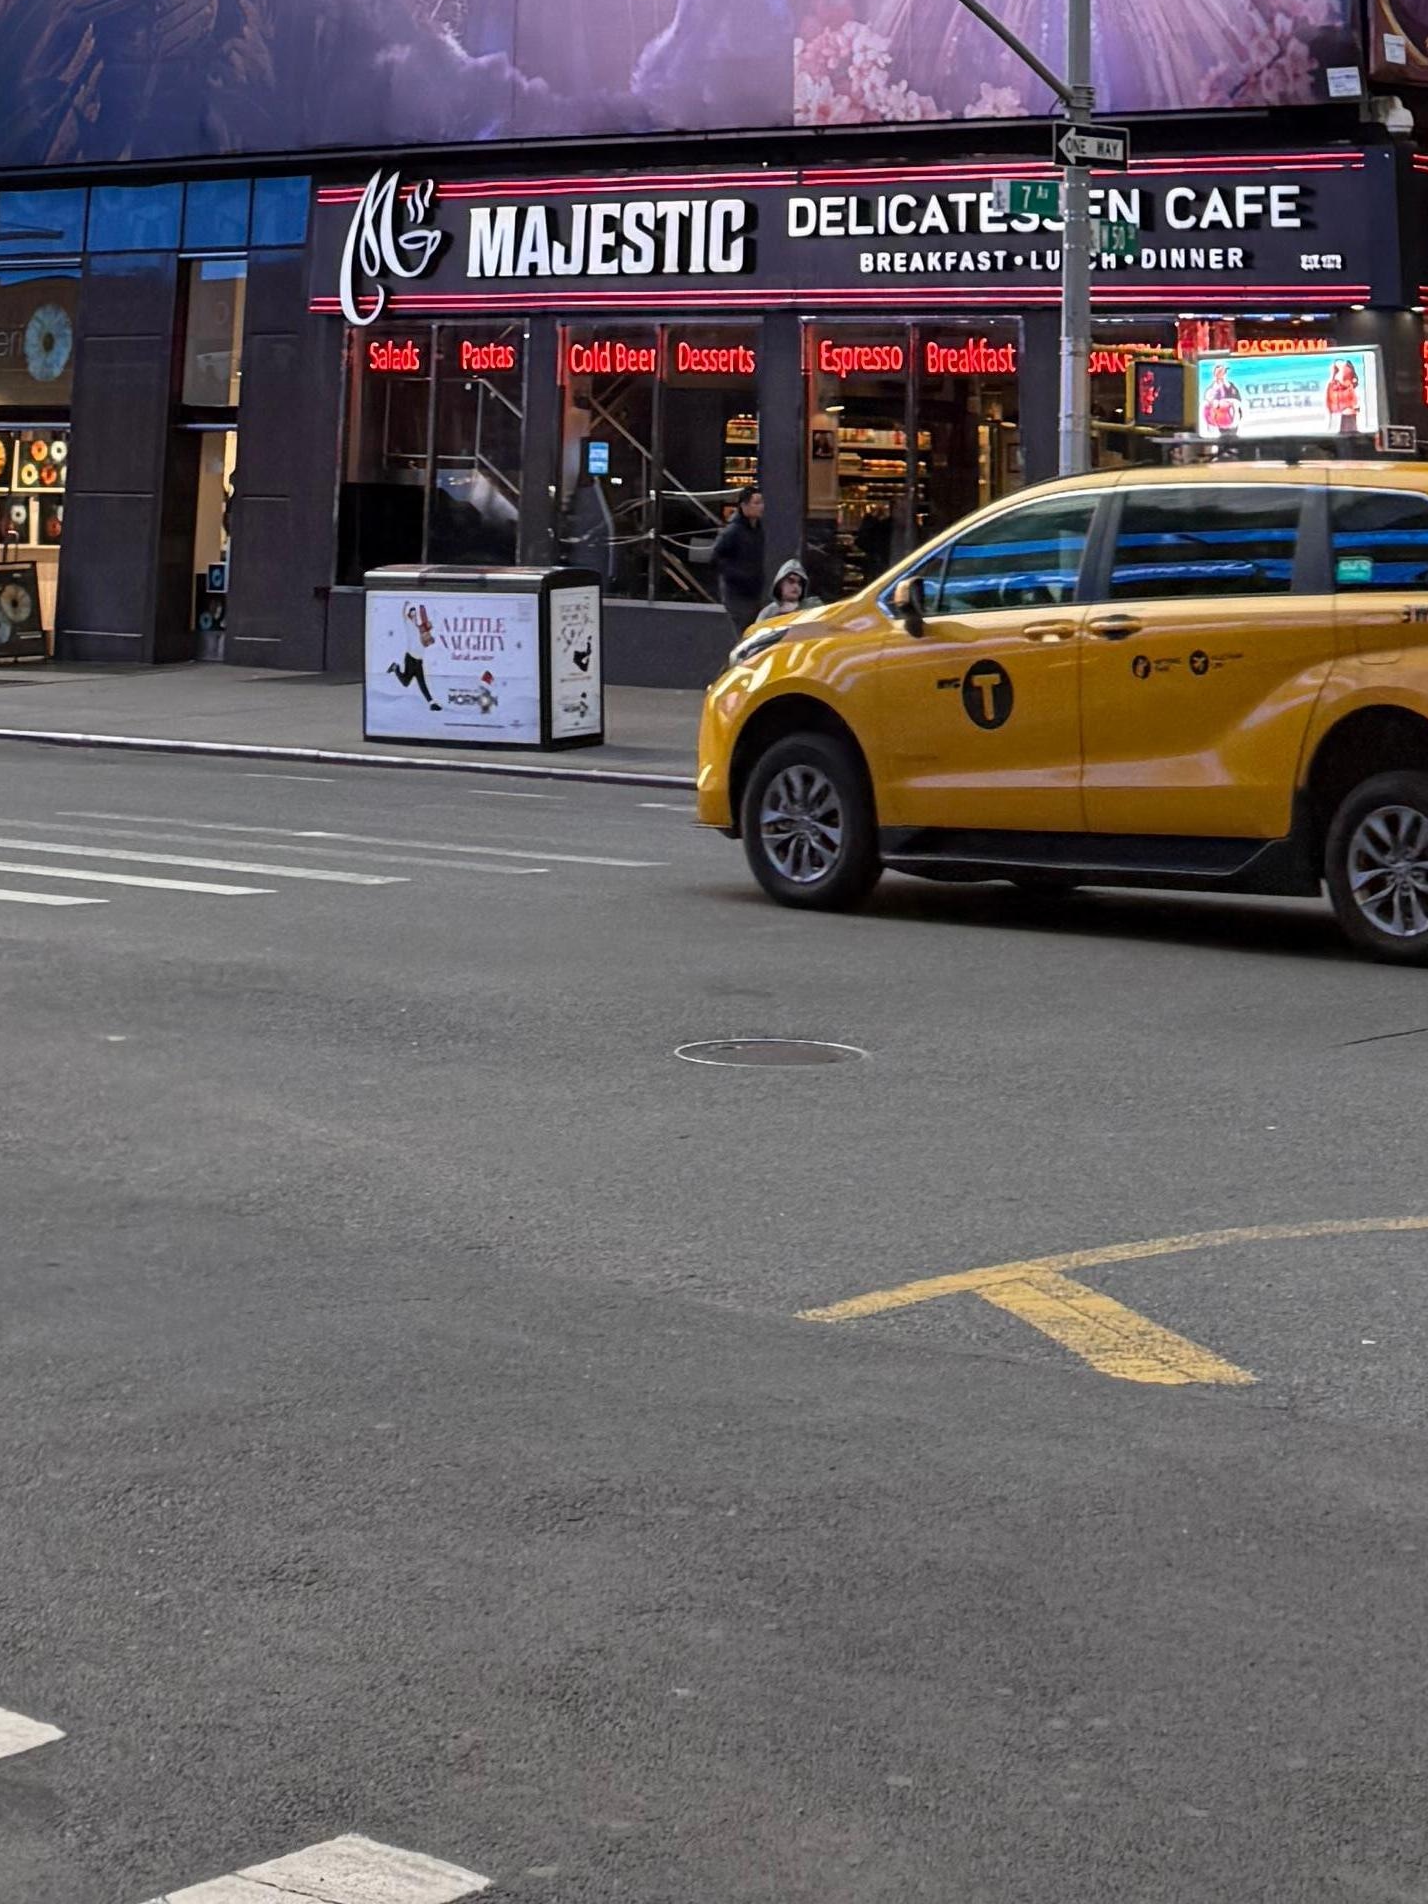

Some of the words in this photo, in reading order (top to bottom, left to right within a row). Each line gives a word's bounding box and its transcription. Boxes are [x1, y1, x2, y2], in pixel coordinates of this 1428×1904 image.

[1066, 136, 1087, 156] ONE
[1097, 141, 1120, 158] WAY
[1022, 185, 1031, 210] 7
[466, 199, 746, 278] MAJESTIC
[788, 188, 1140, 237] DELICATESN
[1165, 185, 1302, 230] CAFE
[860, 249, 1007, 273] BREAKFAST
[1030, 248, 1117, 272] LUH
[1141, 247, 1244, 270] DINNER
[369, 340, 421, 372] Salads
[462, 341, 515, 370] Pastas
[571, 340, 611, 373] Cold
[615, 343, 657, 373] Beer
[678, 343, 756, 374] Desserts
[820, 340, 904, 378] Espresso
[926, 338, 1017, 373] Breakfast
[454, 617, 507, 634] LITTLE
[439, 635, 505, 652] NAUGHTY
[973, 673, 1001, 721] T
